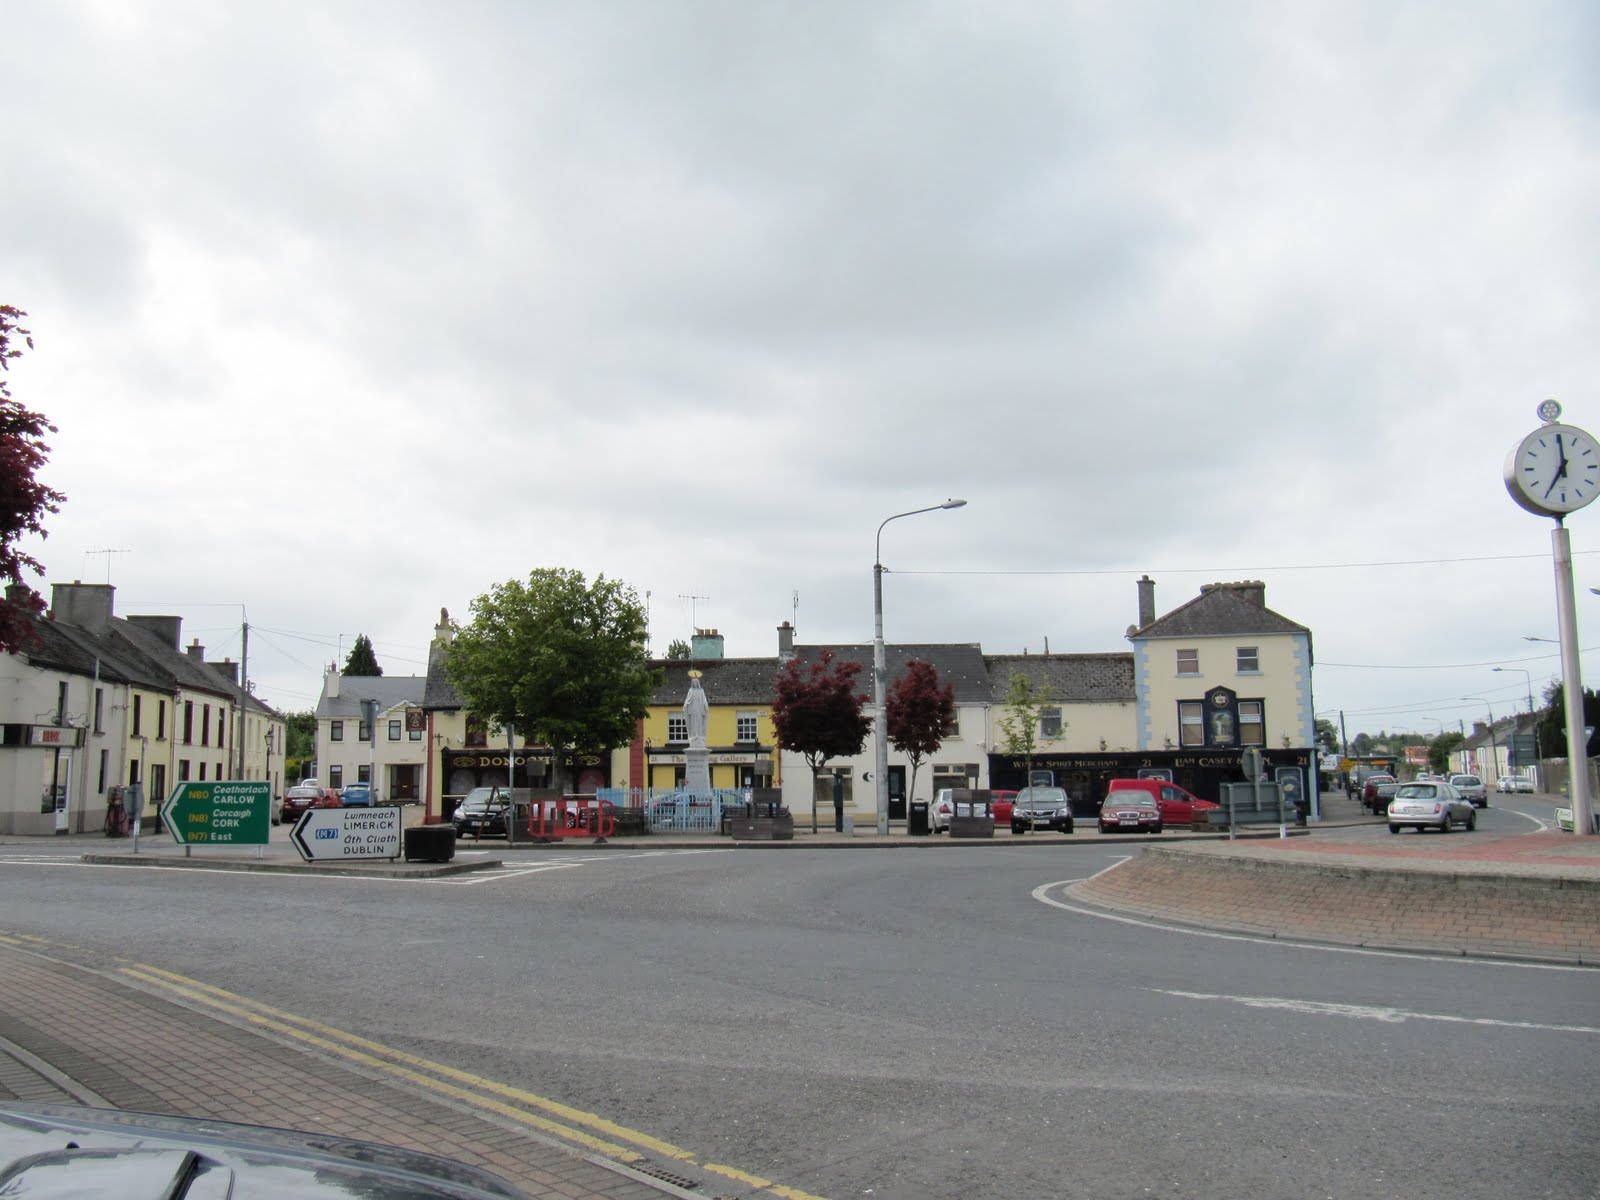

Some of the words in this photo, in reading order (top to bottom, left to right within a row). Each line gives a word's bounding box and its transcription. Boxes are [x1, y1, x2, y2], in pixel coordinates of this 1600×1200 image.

[1142, 759, 1152, 767] 21
[1199, 757, 1233, 767] CASEY
[1297, 756, 1307, 765] 21
[213, 785, 269, 794] Ceatharlach
[188, 791, 209, 799] N80
[213, 796, 255, 804] CARLOW
[212, 808, 251, 818] Corcaigh
[344, 811, 396, 820] Luimneach
[212, 819, 240, 827] CORK
[210, 832, 232, 840] East
[316, 829, 338, 839] (M7)
[366, 835, 397, 843] Cliath
[344, 845, 384, 854] DUBLIN
